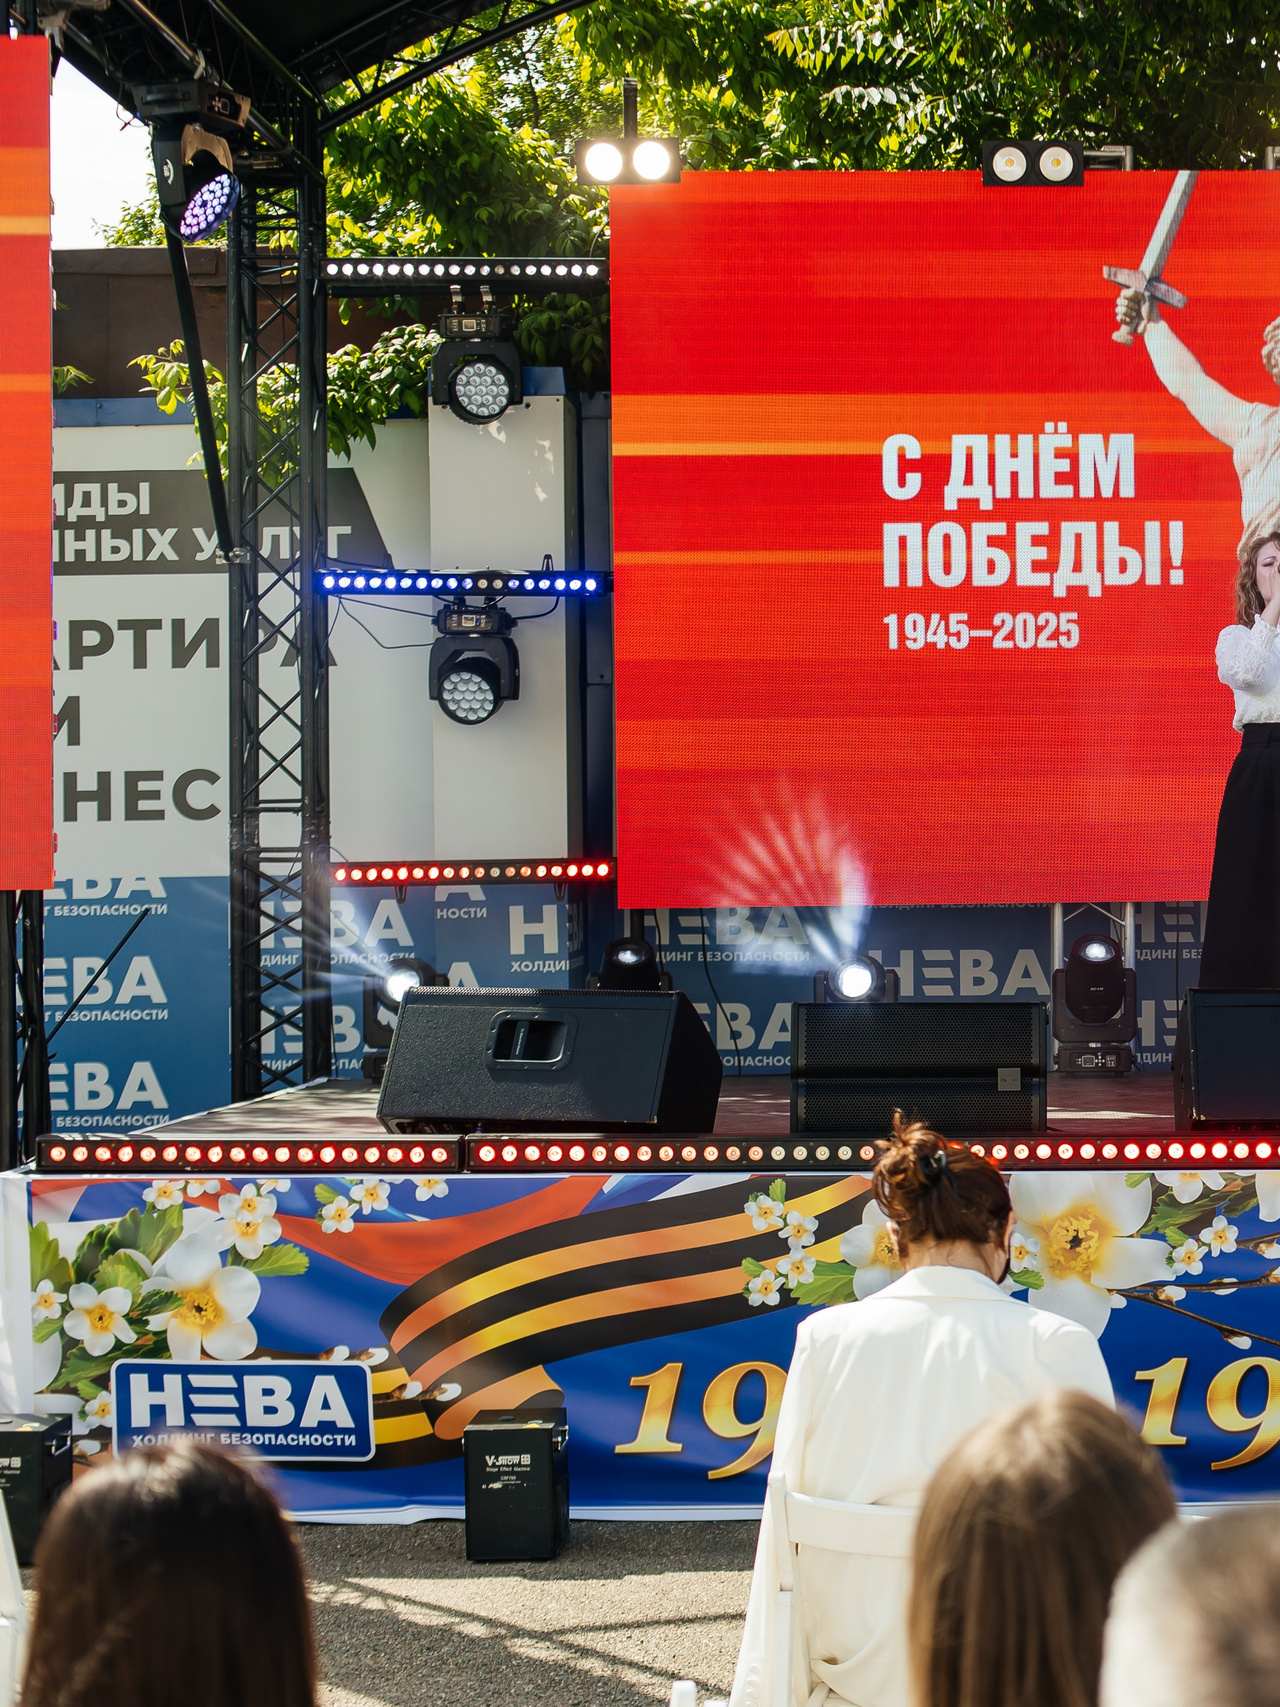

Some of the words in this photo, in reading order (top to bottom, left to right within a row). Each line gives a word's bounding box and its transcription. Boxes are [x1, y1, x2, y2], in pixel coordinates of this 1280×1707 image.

[882, 433, 922, 500] С
[944, 422, 1135, 510] ДНЁМ
[53, 527, 180, 562] НЫХ
[192, 525, 352, 561] УЛГ
[883, 520, 1184, 597] ПОБЕДЫ!
[43, 955, 168, 1006] ЕВА
[261, 953, 299, 966] ДИНГ
[868, 949, 1051, 997] НЕВА
[48, 1061, 169, 1111] ЕВА
[56, 1113, 170, 1128] БЕЗОПАСНОСТИ
[129, 1373, 356, 1429] НЕВА
[220, 1433, 357, 1447] БЕЗОПАСНОСТИ
